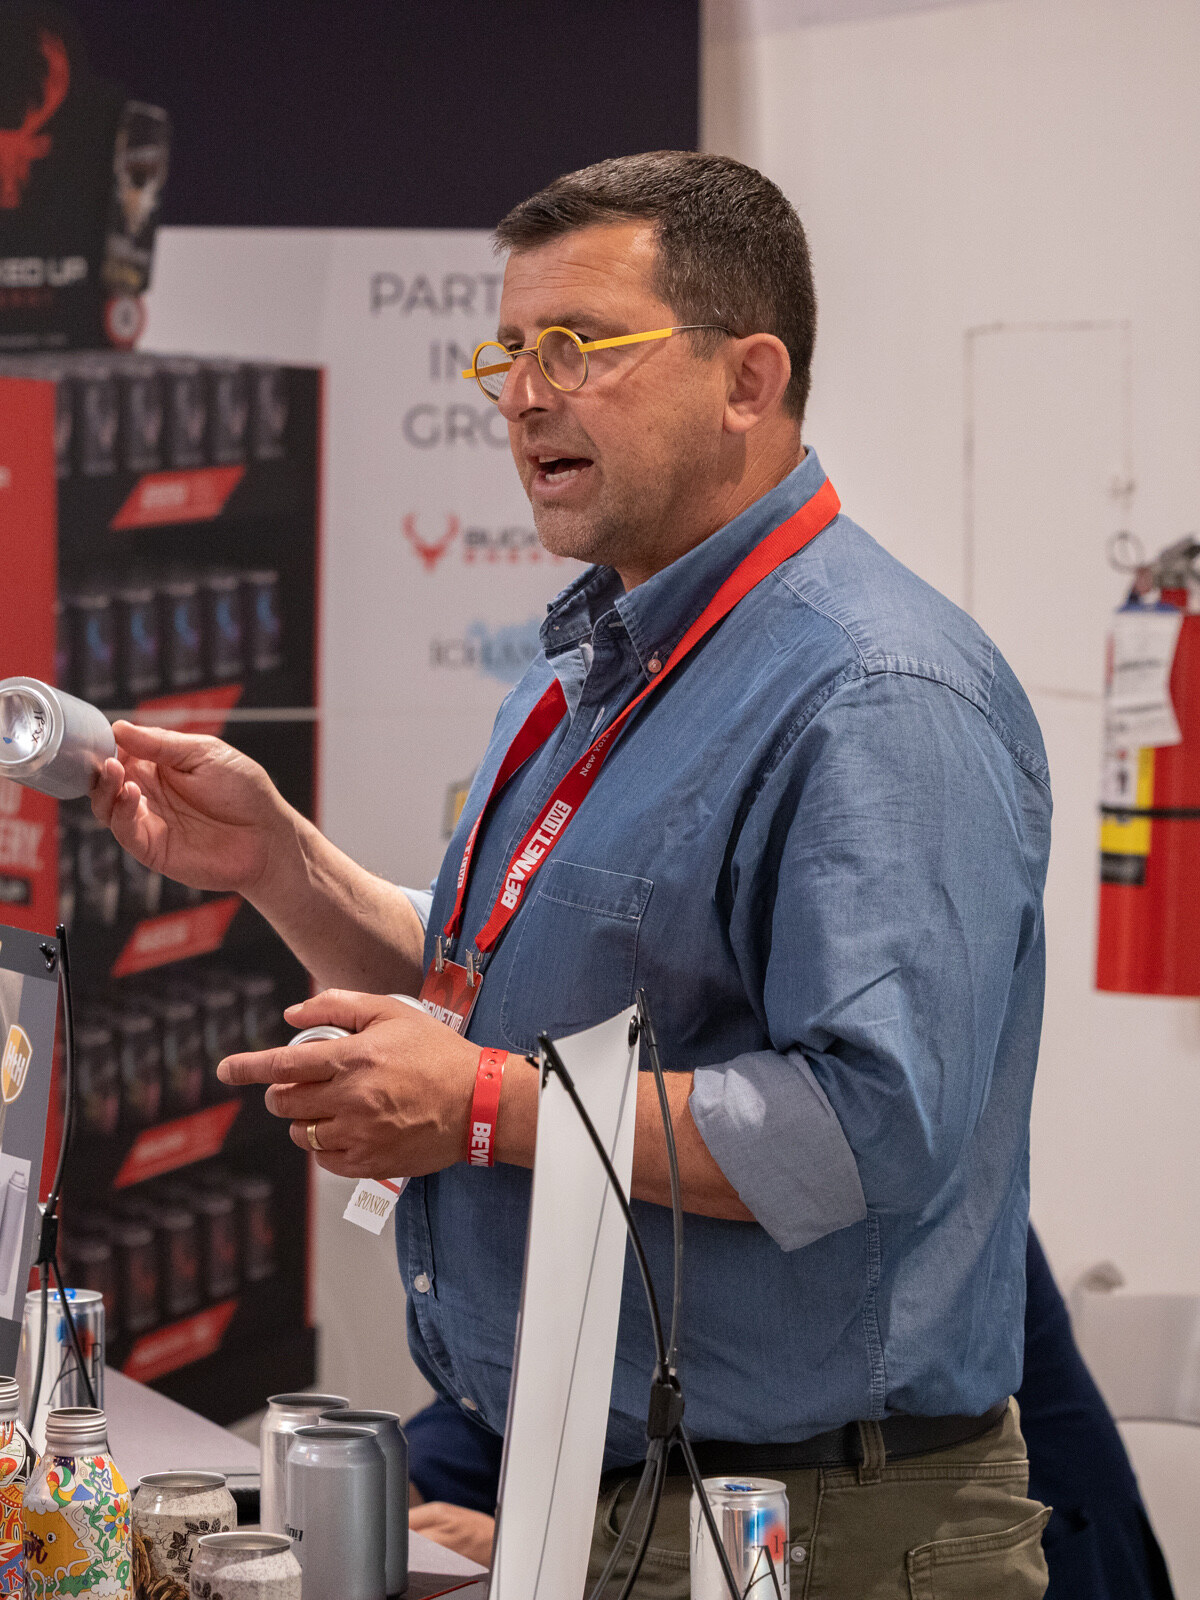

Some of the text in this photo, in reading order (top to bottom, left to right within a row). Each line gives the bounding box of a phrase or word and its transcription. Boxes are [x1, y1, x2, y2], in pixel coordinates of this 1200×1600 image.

[369, 271, 502, 315] PART
[402, 402, 509, 448] GRO
[579, 754, 596, 777] New
[354, 1190, 390, 1217] SPONSOR
